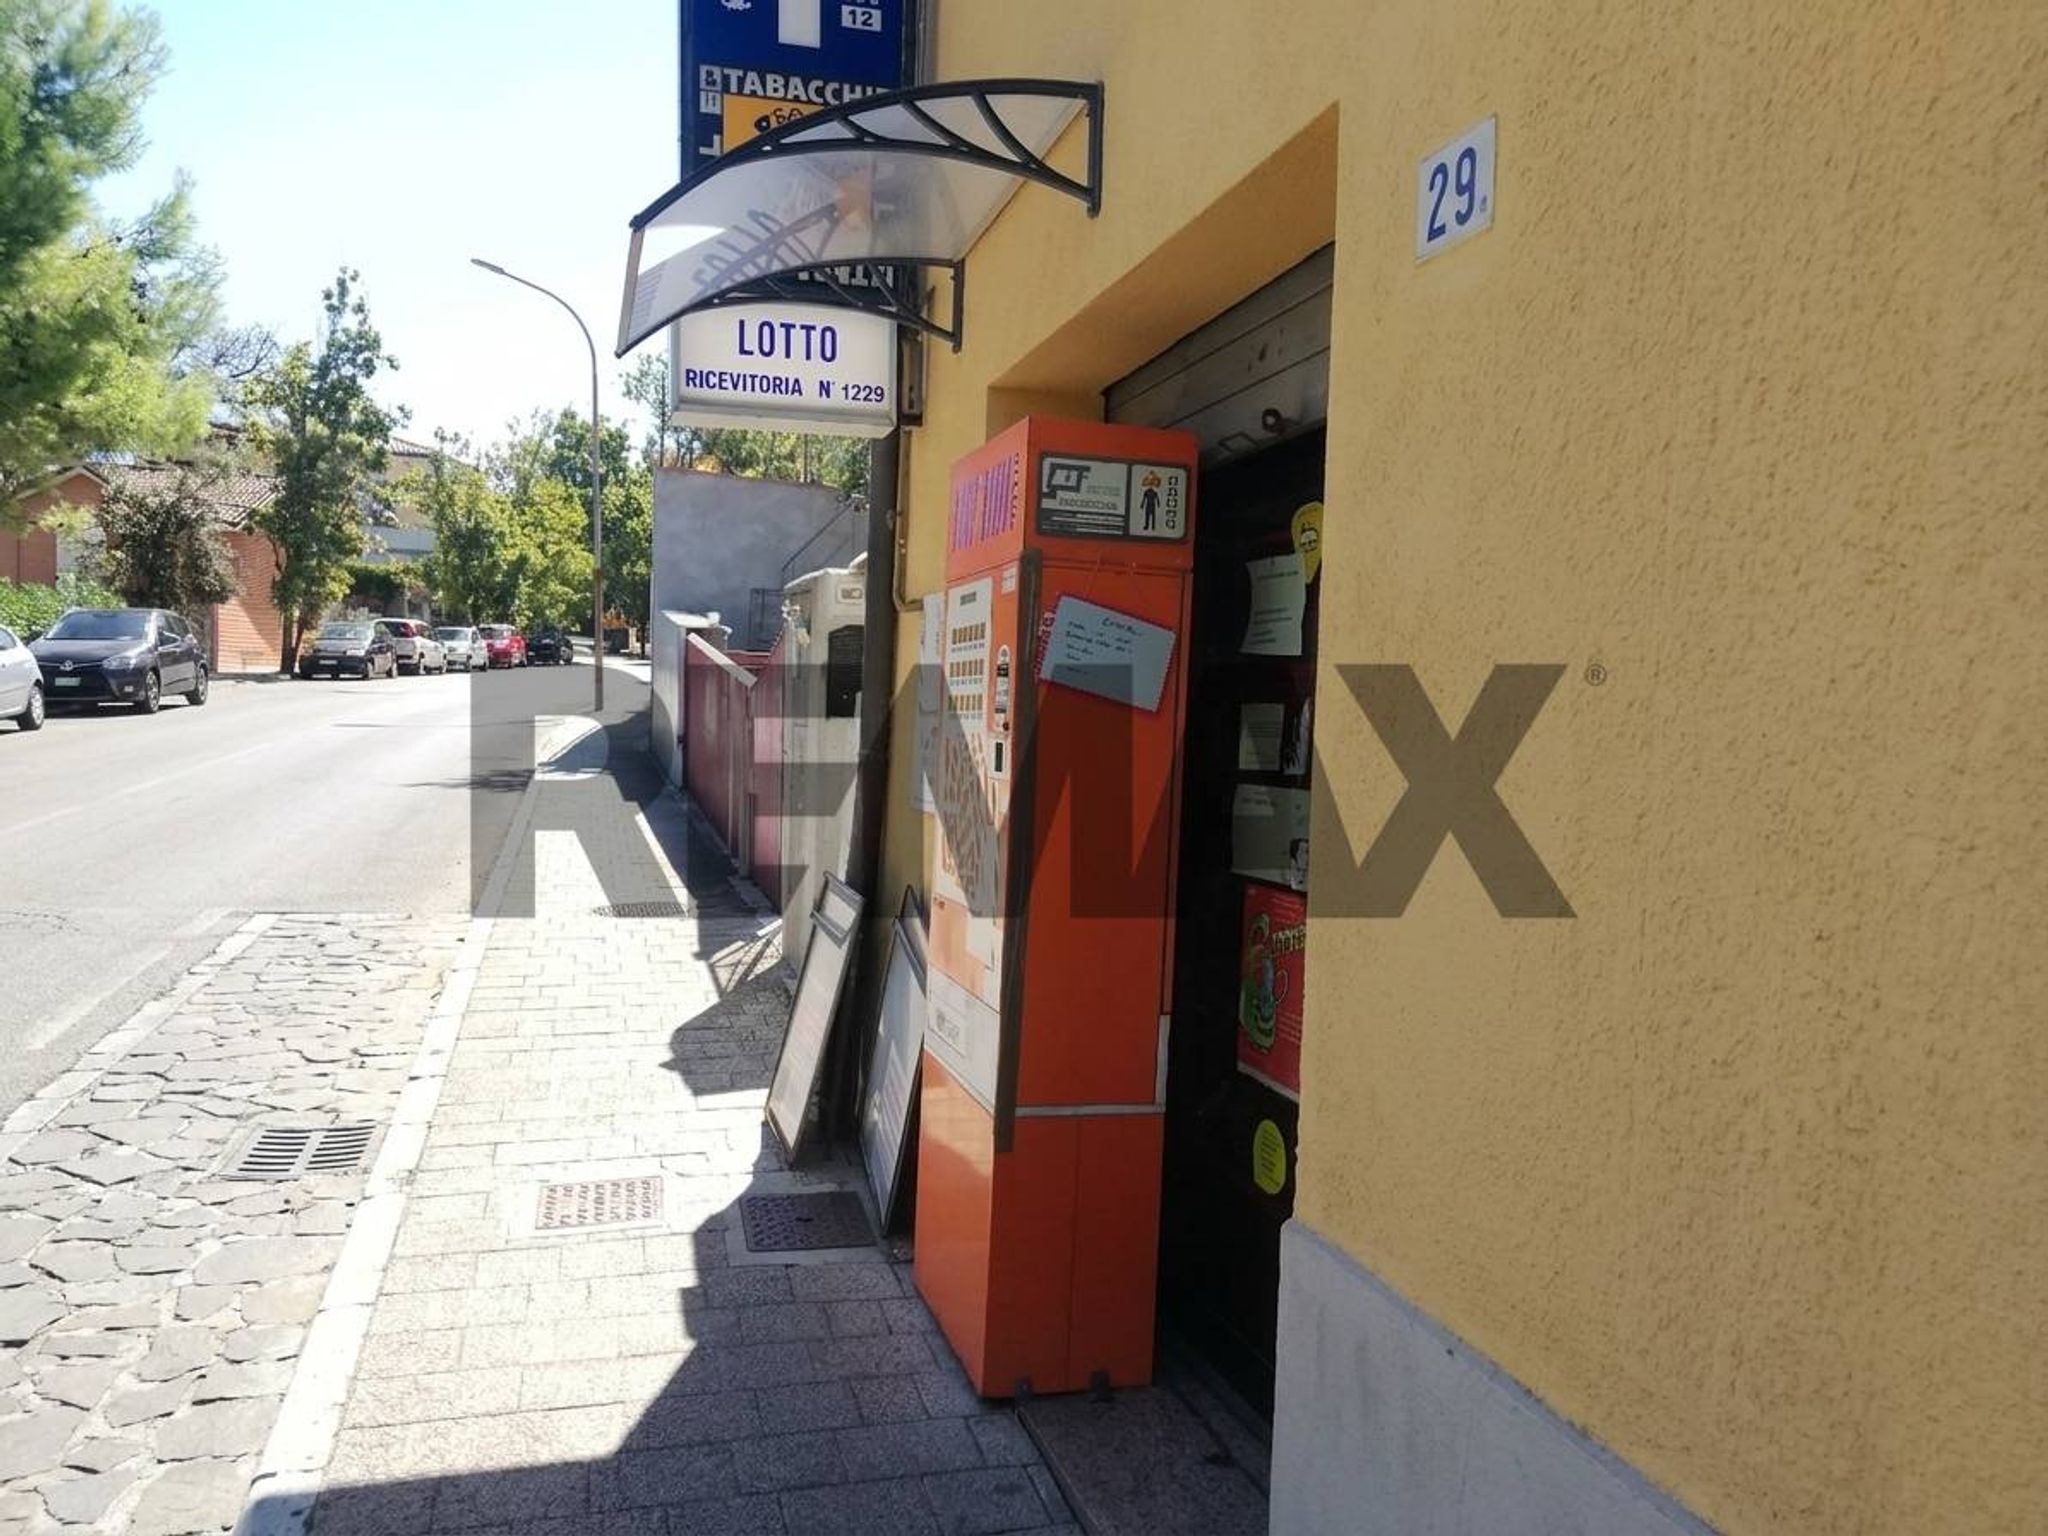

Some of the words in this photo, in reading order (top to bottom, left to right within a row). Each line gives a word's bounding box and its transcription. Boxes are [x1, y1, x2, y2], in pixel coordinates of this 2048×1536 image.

[848, 8, 874, 27] 12
[1427, 147, 1477, 243] 29
[738, 318, 837, 363] LOTTO
[685, 368, 803, 397] RICEVITORIA
[841, 383, 885, 403] 1229
